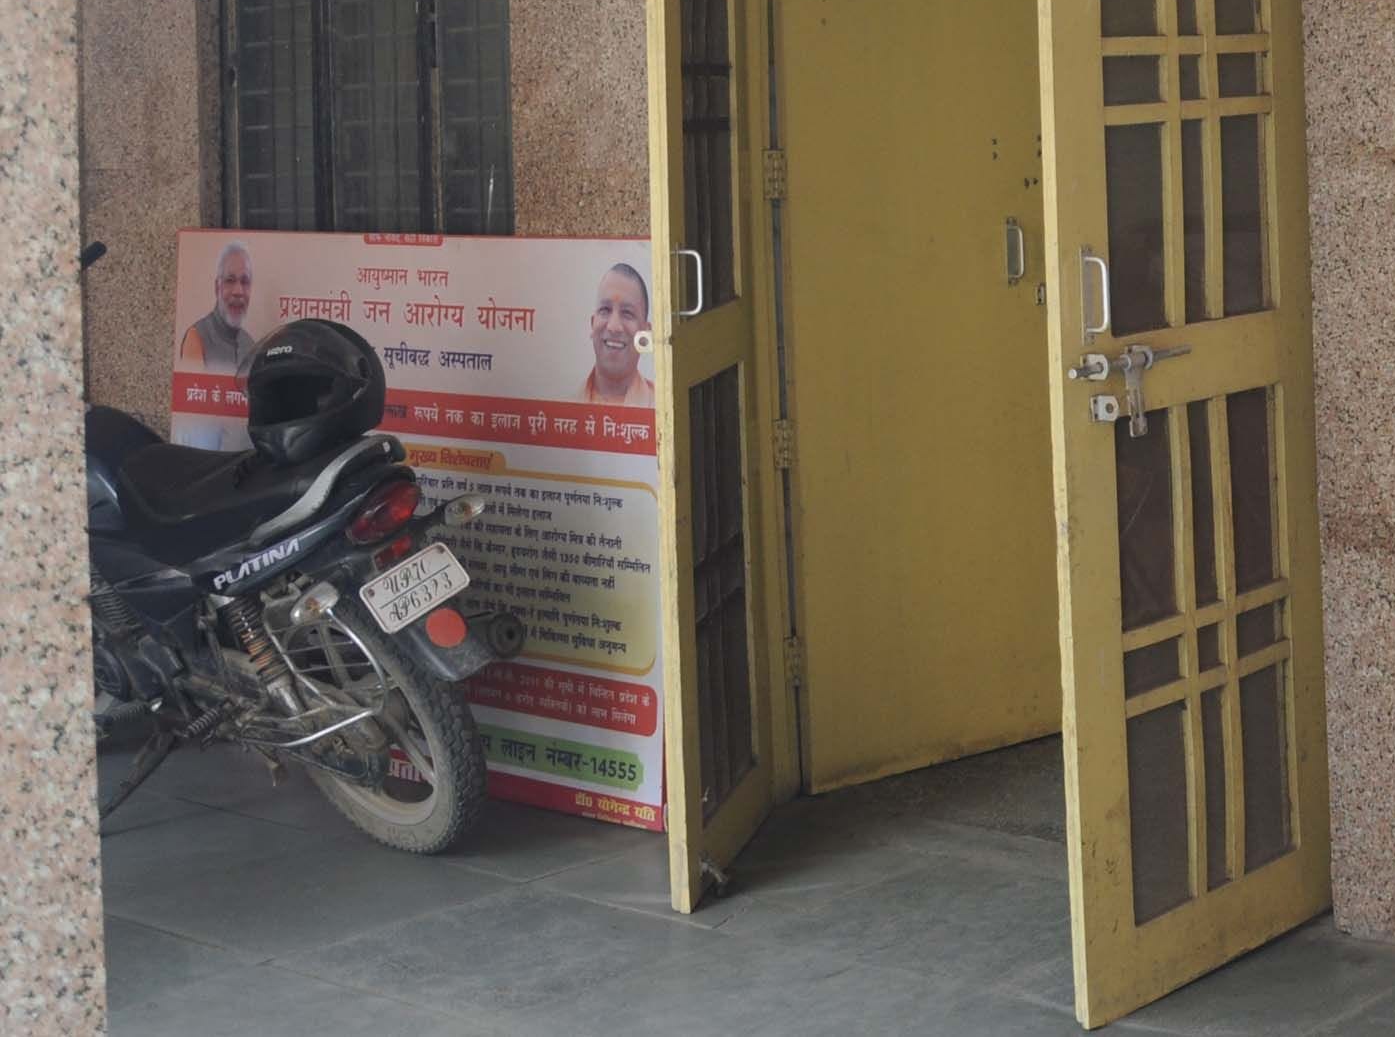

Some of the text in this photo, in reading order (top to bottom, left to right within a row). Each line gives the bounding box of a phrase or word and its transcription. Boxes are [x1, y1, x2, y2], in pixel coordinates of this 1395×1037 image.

[356, 265, 449, 291] आयुष्मान भारत
[363, 300, 391, 324] जन
[406, 295, 464, 328] आरोग्य
[476, 297, 535, 332] योजना
[440, 351, 492, 371] अस्पताल
[187, 383, 248, 407] प्रदेश के लगभ
[445, 408, 463, 425] तक
[471, 412, 484, 426] का
[492, 412, 520, 430] इलाज
[528, 411, 547, 435] पूरी
[554, 418, 578, 435] तरह
[585, 417, 595, 436] से
[214, 538, 300, 590] PLATINA
